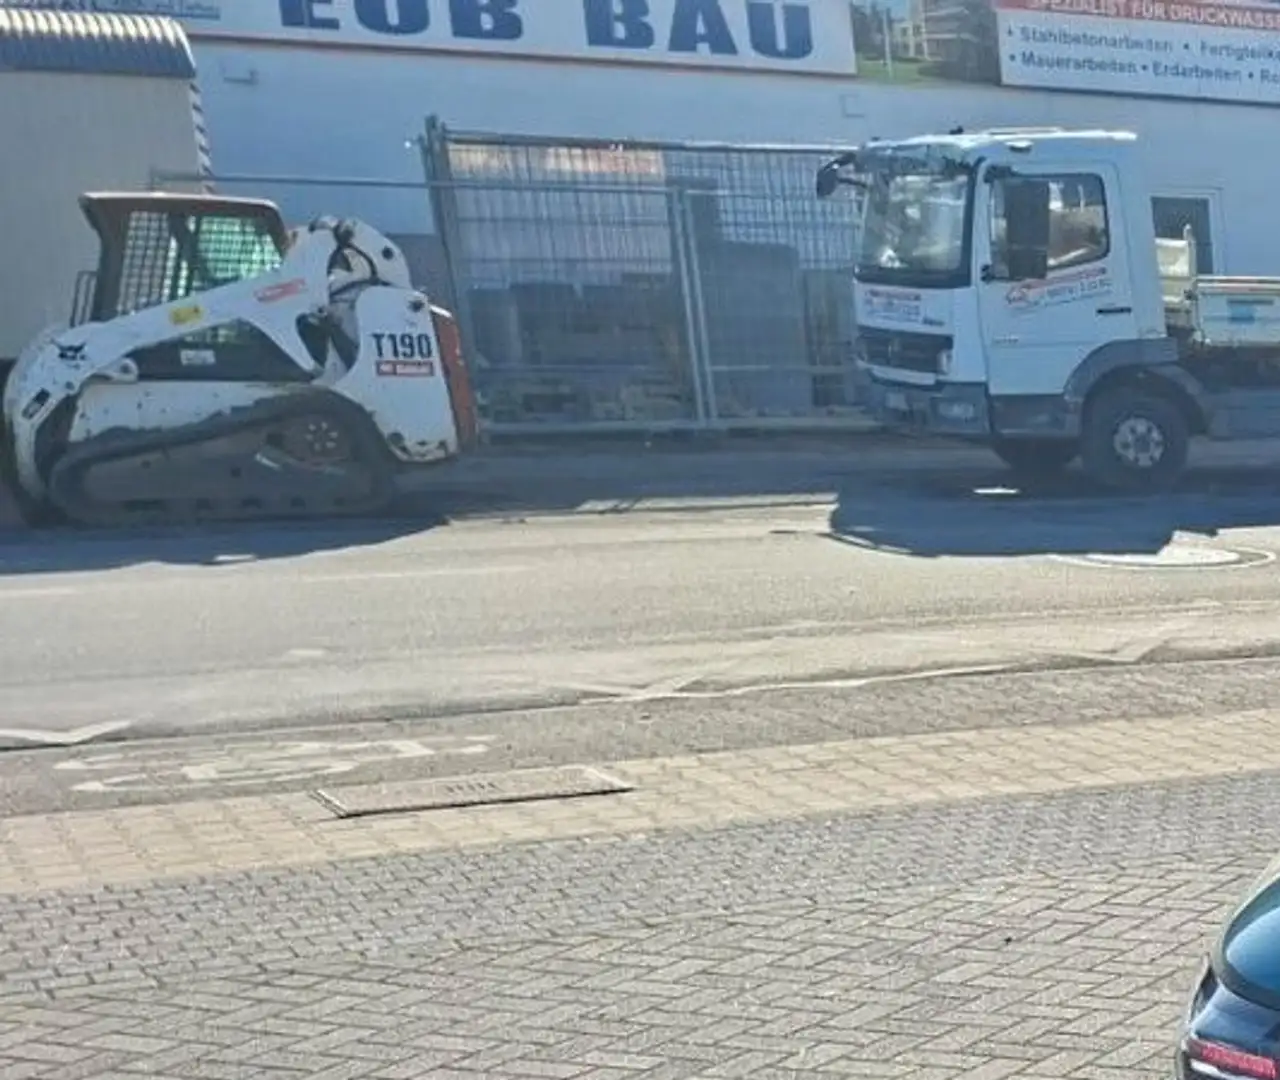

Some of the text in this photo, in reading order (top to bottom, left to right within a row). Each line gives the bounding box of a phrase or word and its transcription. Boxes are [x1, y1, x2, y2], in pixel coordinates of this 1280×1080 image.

[1132, 3, 1167, 21] FÜR
[583, 0, 813, 60] BAU
[1020, 51, 1138, 73] Mauerarbeiten
[1152, 62, 1242, 82] Erdarbeiten
[371, 333, 433, 358] T190
